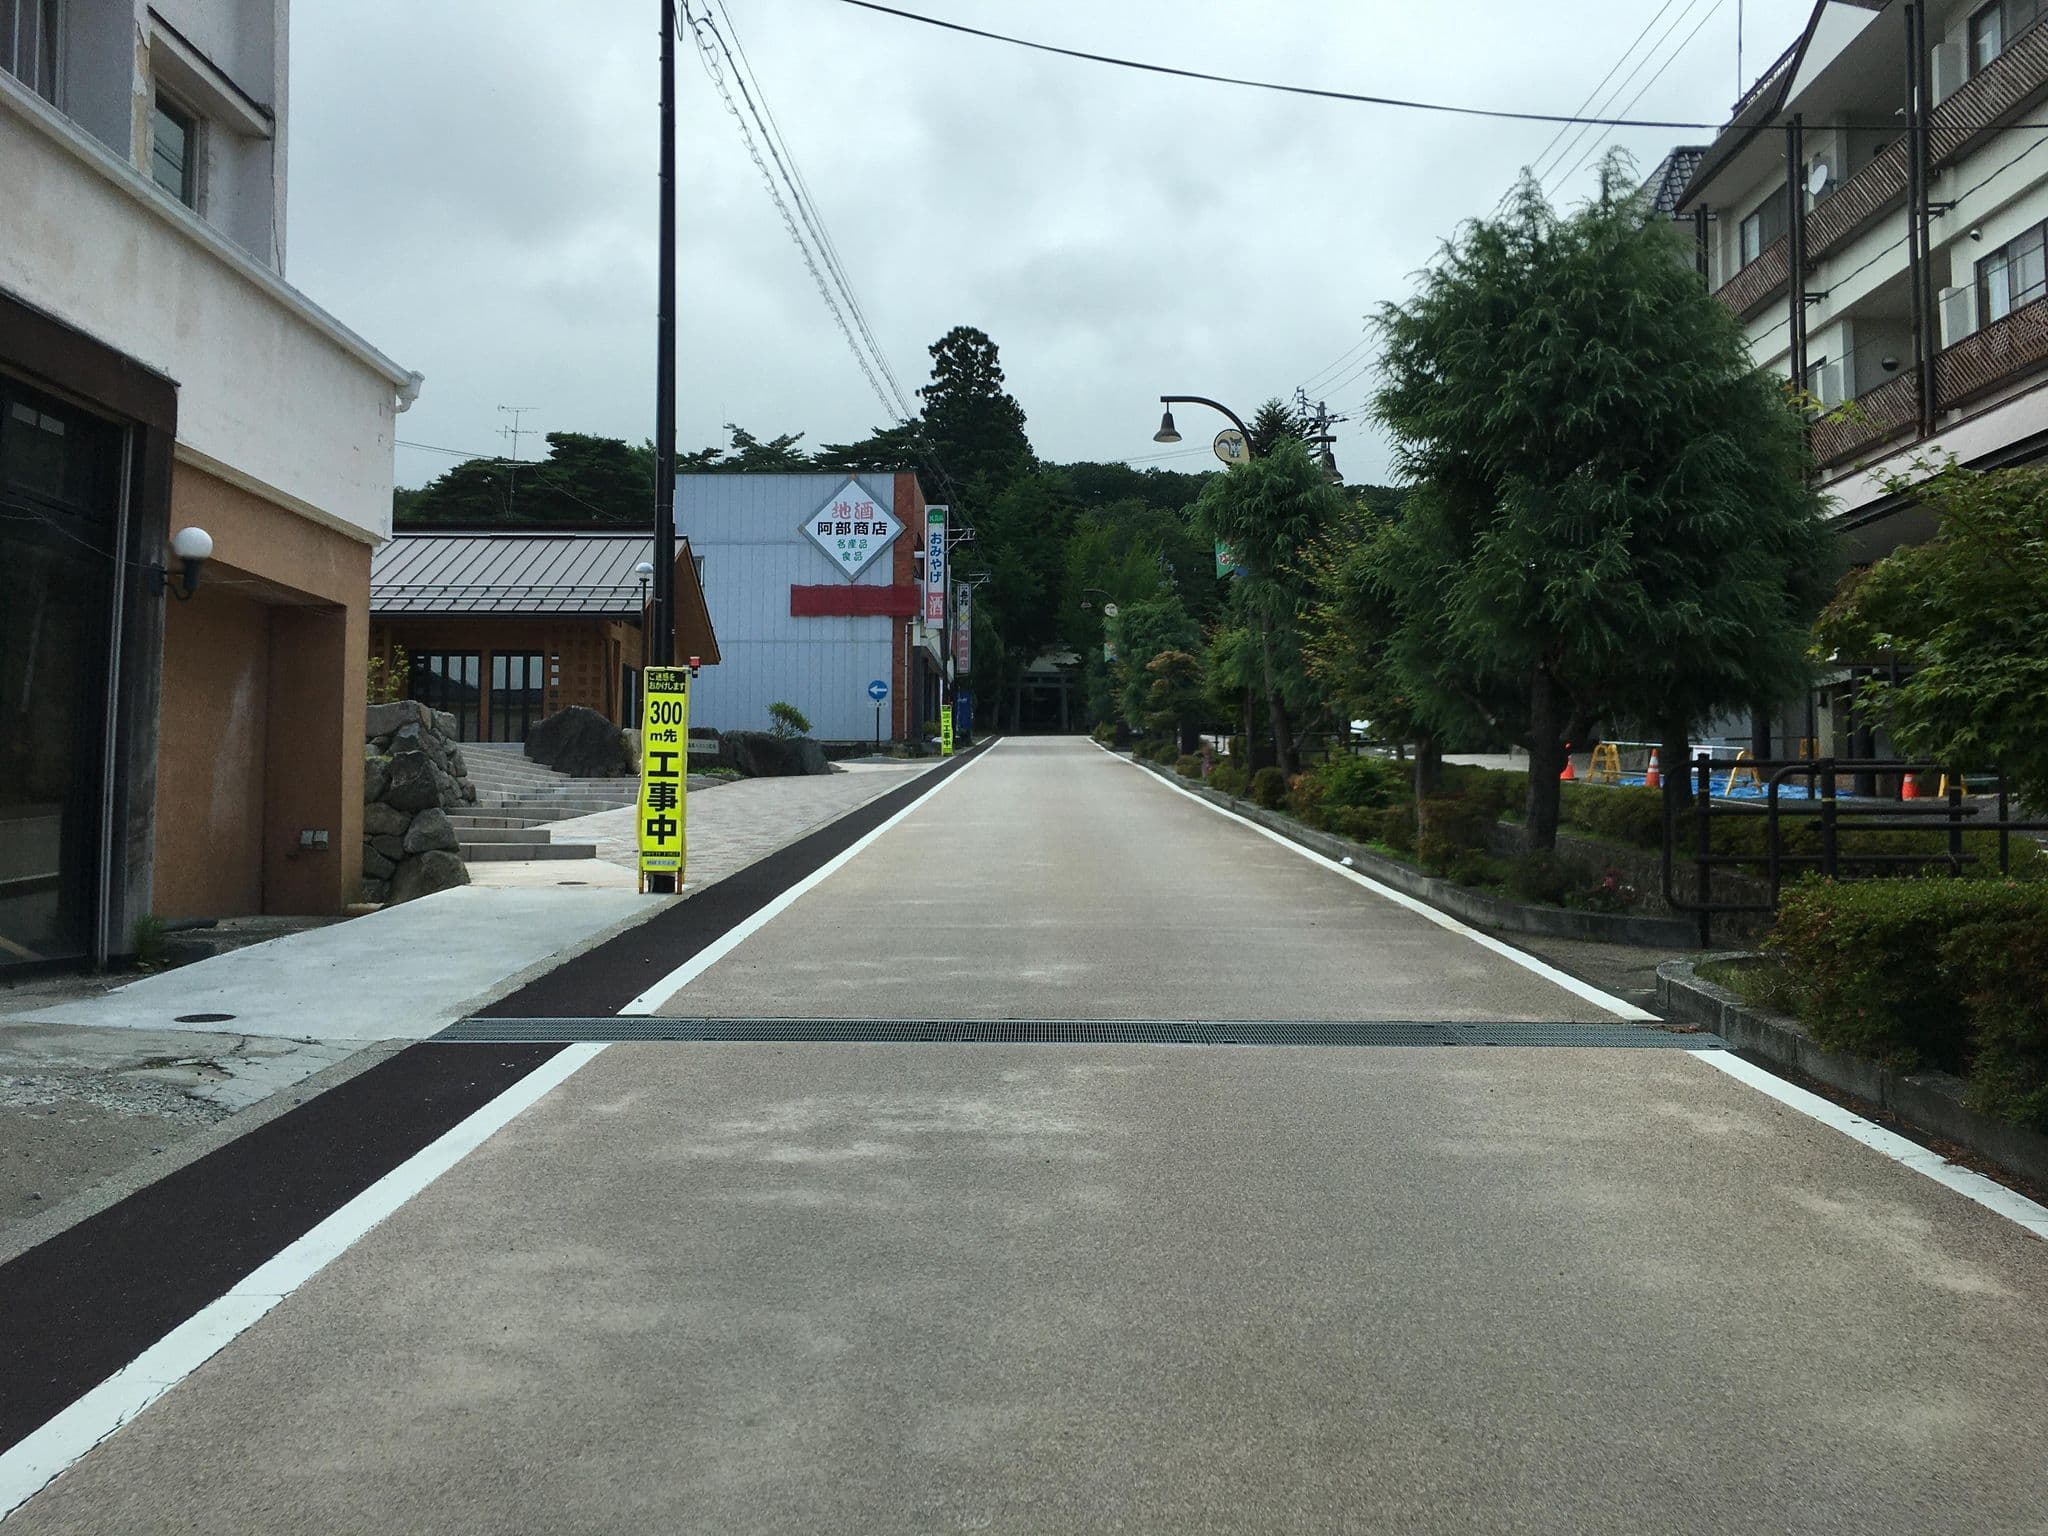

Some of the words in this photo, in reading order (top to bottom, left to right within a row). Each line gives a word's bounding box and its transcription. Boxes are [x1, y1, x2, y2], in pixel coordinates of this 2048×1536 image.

[832, 501, 874, 519] 地酒
[817, 521, 887, 536] 阿部商店
[837, 539, 867, 549] 名産品
[842, 551, 863, 561] 食品
[930, 532, 943, 583] おみやげ
[930, 595, 943, 616] 酒
[649, 681, 685, 691] おかけします
[650, 701, 682, 725] 300
[650, 729, 677, 743] m先
[647, 751, 679, 845] 工事中
